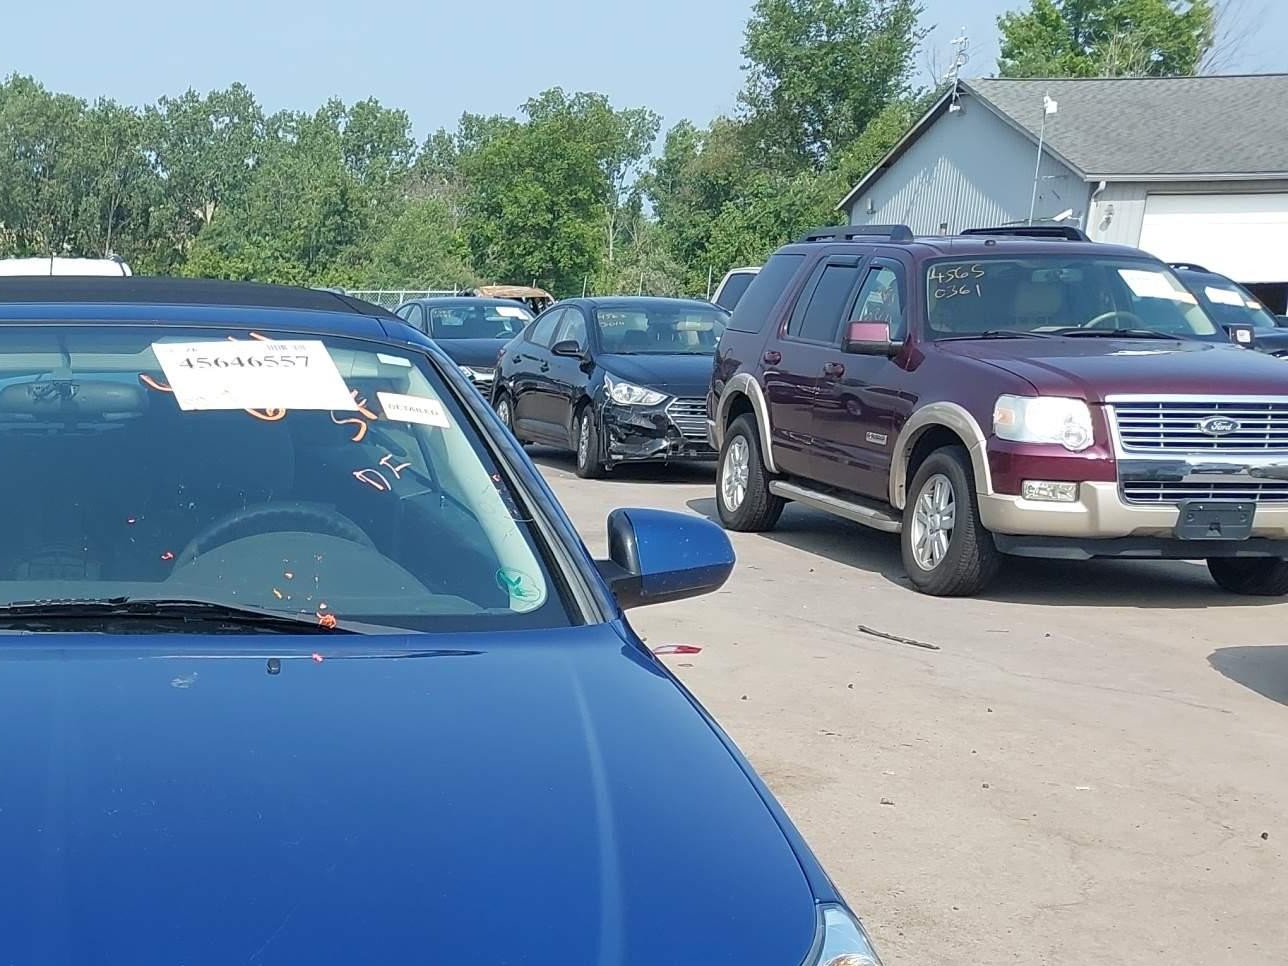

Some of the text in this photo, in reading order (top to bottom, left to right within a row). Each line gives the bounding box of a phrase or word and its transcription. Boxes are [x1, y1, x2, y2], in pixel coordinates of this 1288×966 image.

[928, 263, 985, 283] 4565
[934, 284, 982, 299] 0361
[178, 355, 310, 369] 45646557
